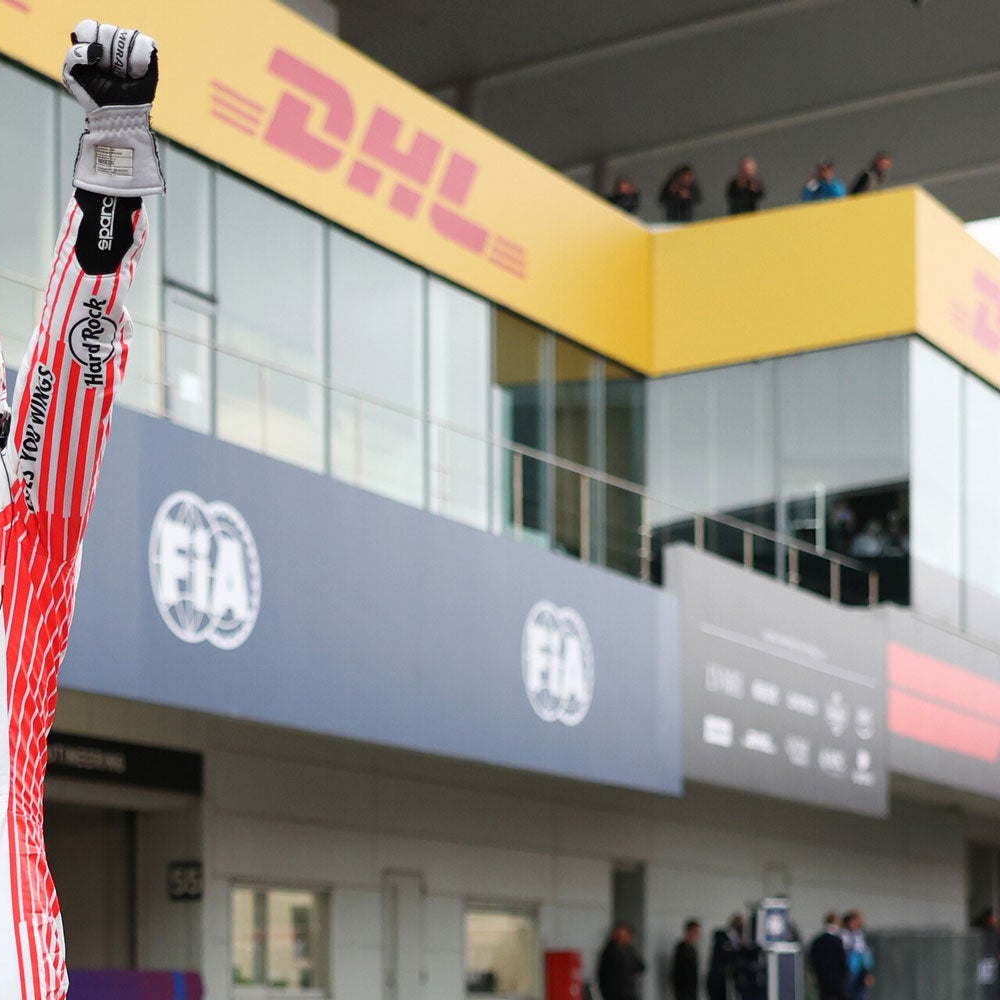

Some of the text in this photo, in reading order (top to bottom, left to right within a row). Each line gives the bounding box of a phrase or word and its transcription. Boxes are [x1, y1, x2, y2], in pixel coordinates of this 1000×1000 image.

[262, 46, 488, 256] DHL
[98, 197, 116, 250] sparc
[82, 297, 107, 387] Hard Rock
[30, 365, 54, 425] WINGS
[20, 424, 41, 462] YOU
[156, 517, 251, 622] FIA
[524, 621, 590, 707] FIA
